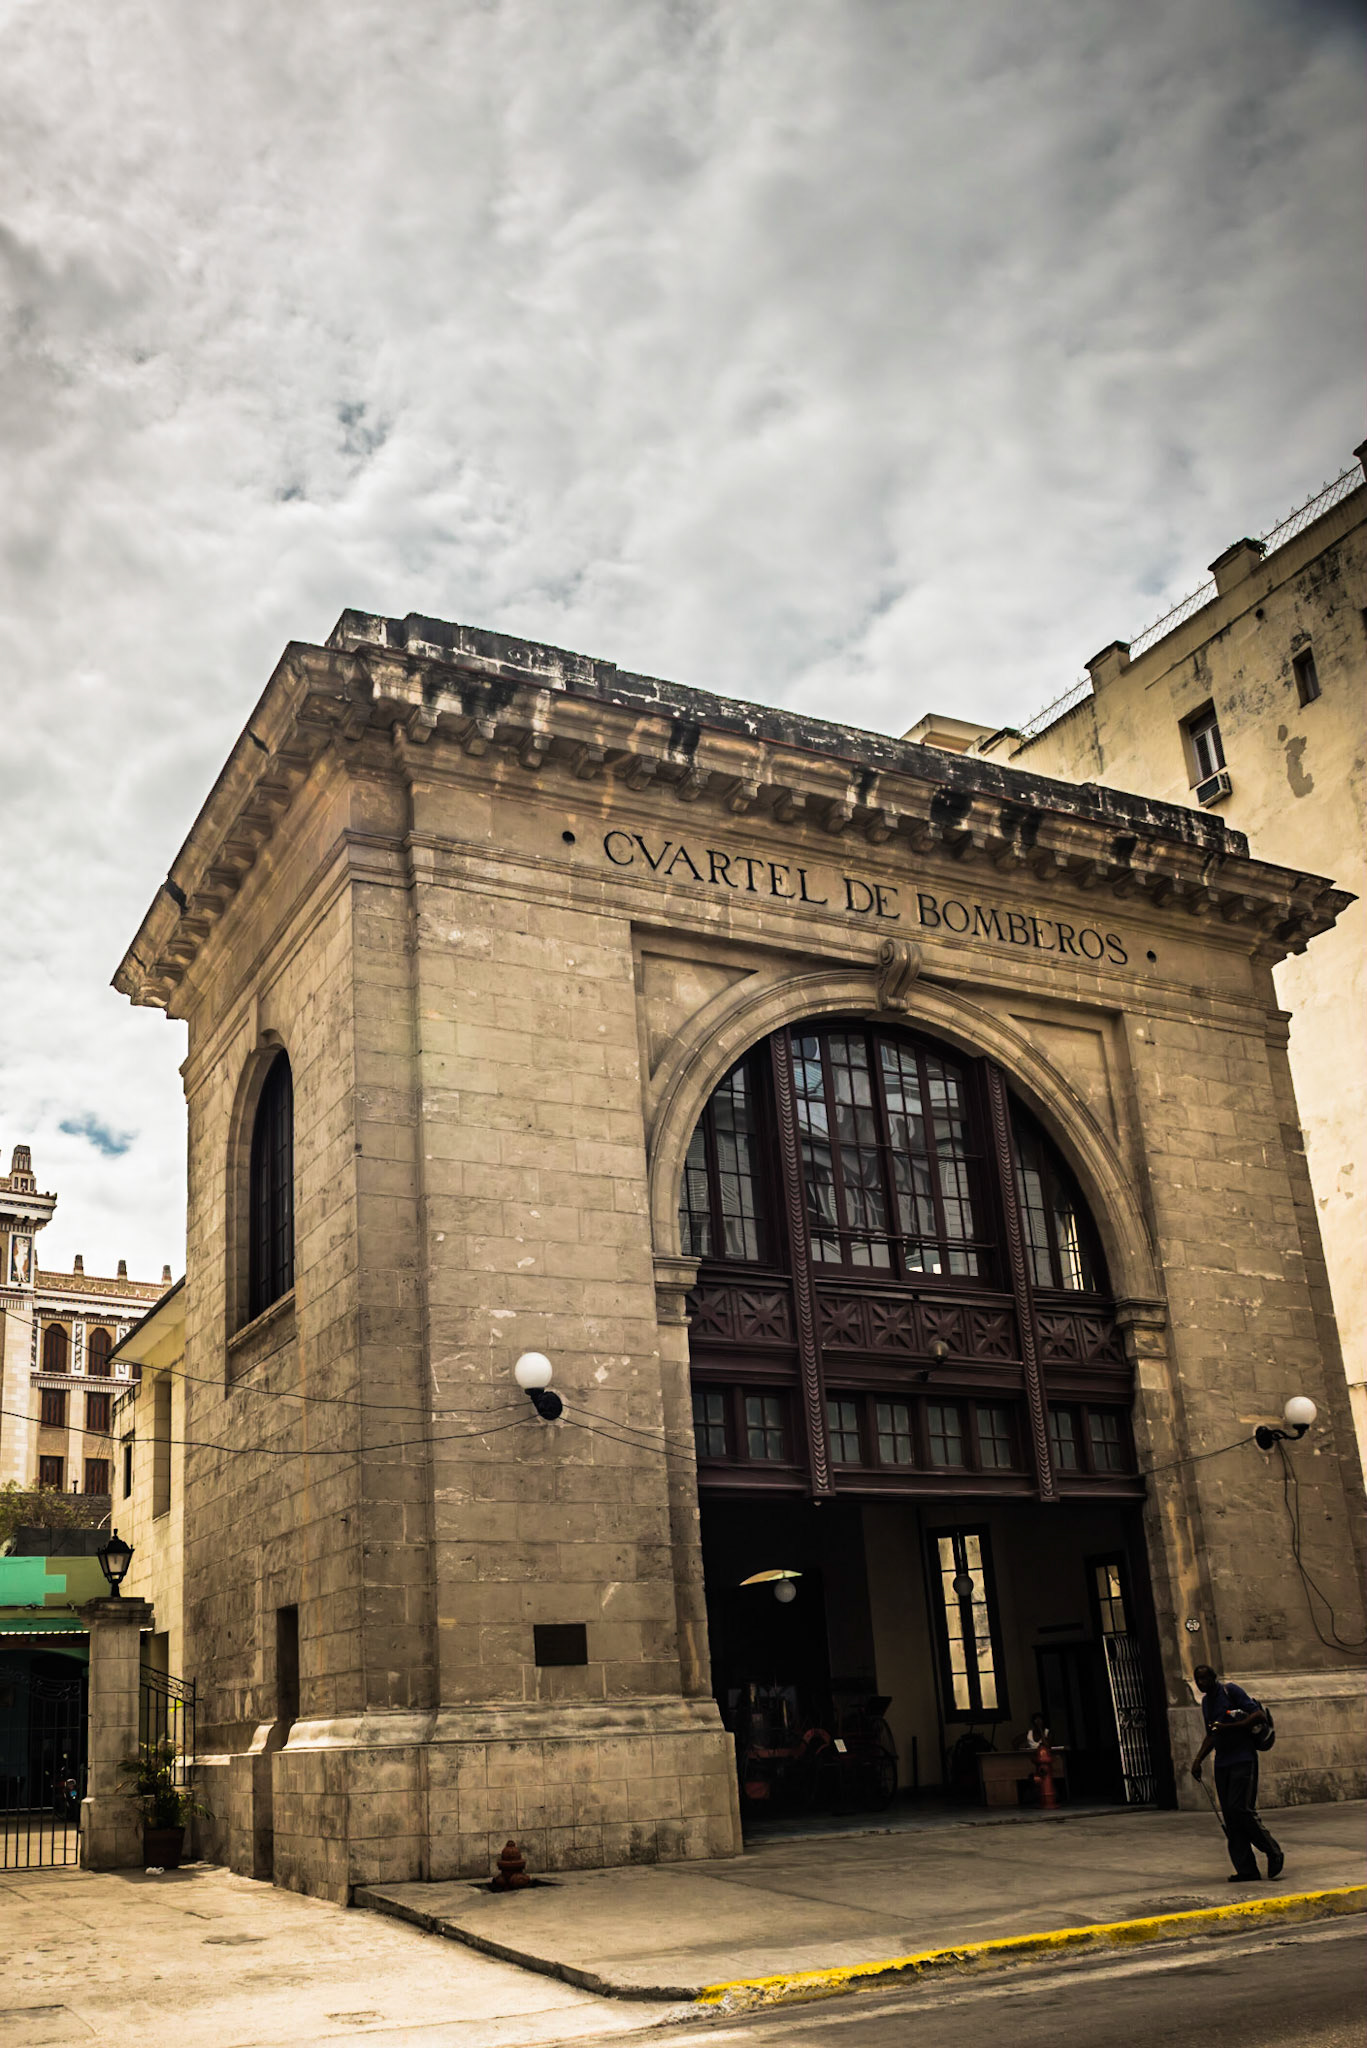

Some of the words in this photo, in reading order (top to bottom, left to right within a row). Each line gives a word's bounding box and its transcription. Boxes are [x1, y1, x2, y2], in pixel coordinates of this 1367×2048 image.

[603, 830, 828, 905] CVARTEL
[843, 877, 901, 919] DE
[916, 892, 1128, 965] BOMBEROS
